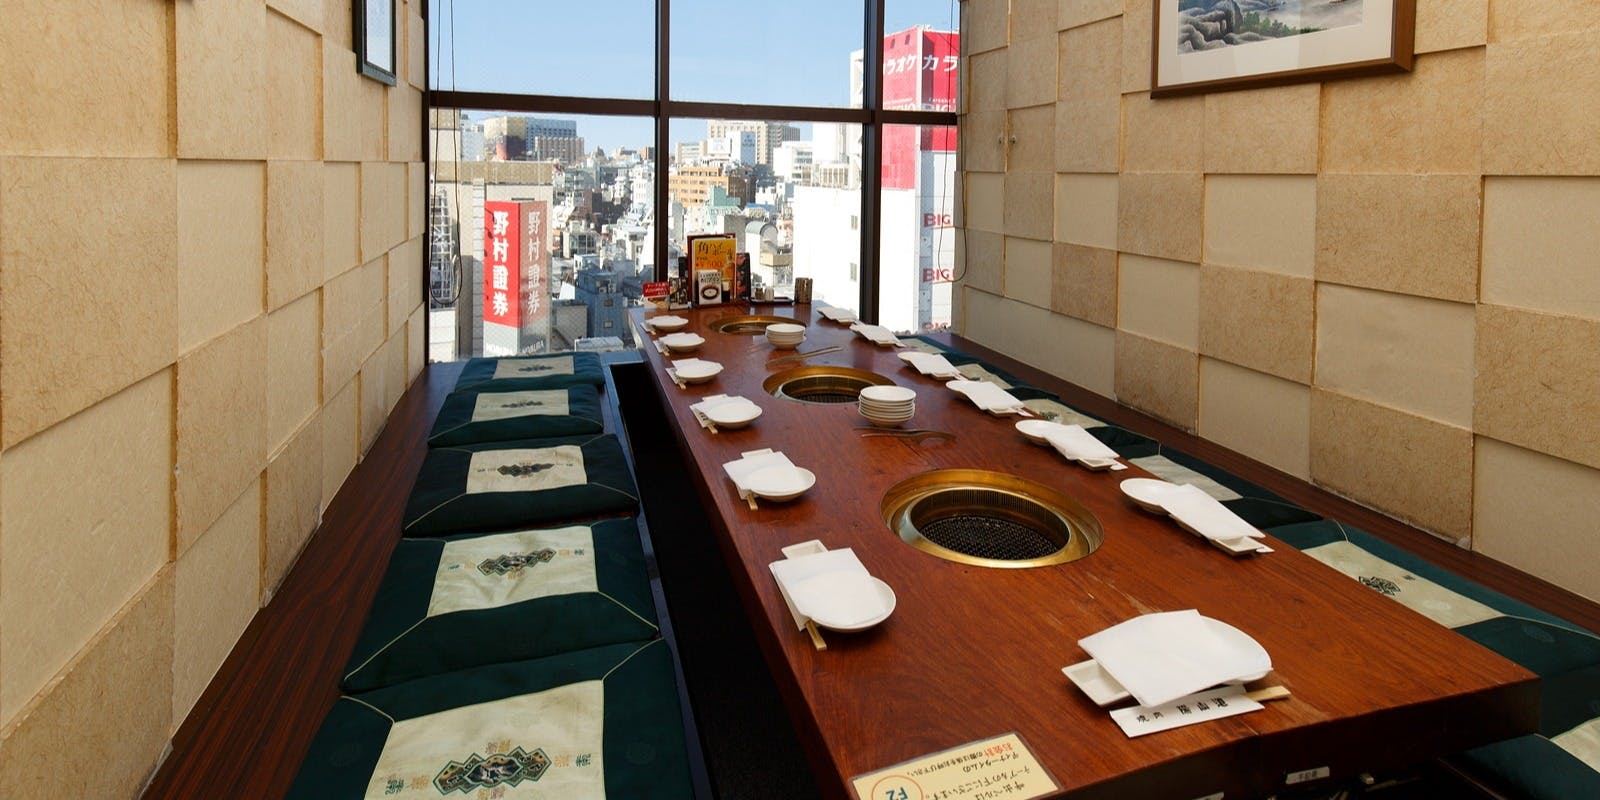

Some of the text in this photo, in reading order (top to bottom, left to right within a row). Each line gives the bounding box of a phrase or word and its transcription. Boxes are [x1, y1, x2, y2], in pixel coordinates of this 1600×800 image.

[922, 54, 958, 72] カラ
[923, 213, 951, 227] BIG
[492, 210, 509, 317] 野村證券
[885, 786, 908, 800] F2
